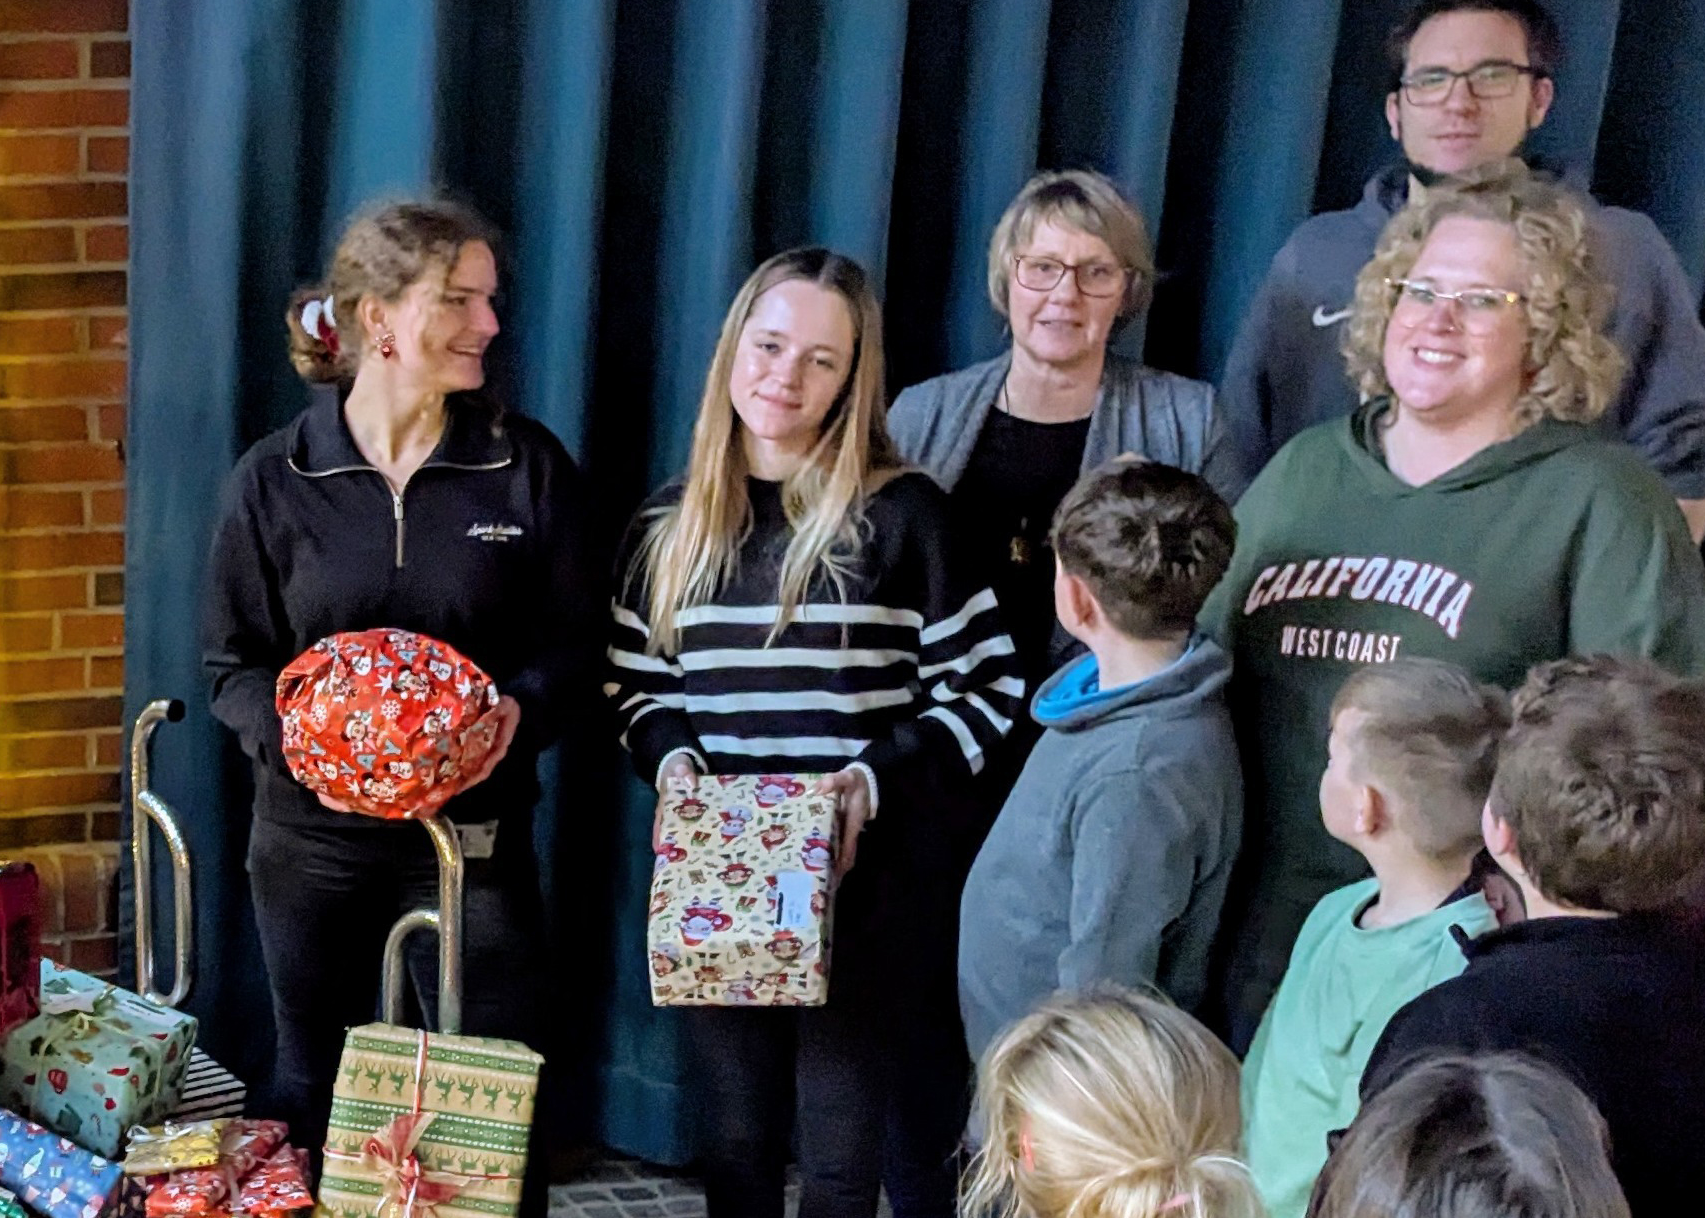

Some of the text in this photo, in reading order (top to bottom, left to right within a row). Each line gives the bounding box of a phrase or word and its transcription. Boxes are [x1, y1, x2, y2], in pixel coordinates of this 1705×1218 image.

[1243, 556, 1474, 640] CALIFORNIA
[1280, 624, 1401, 663] WEST COAST
